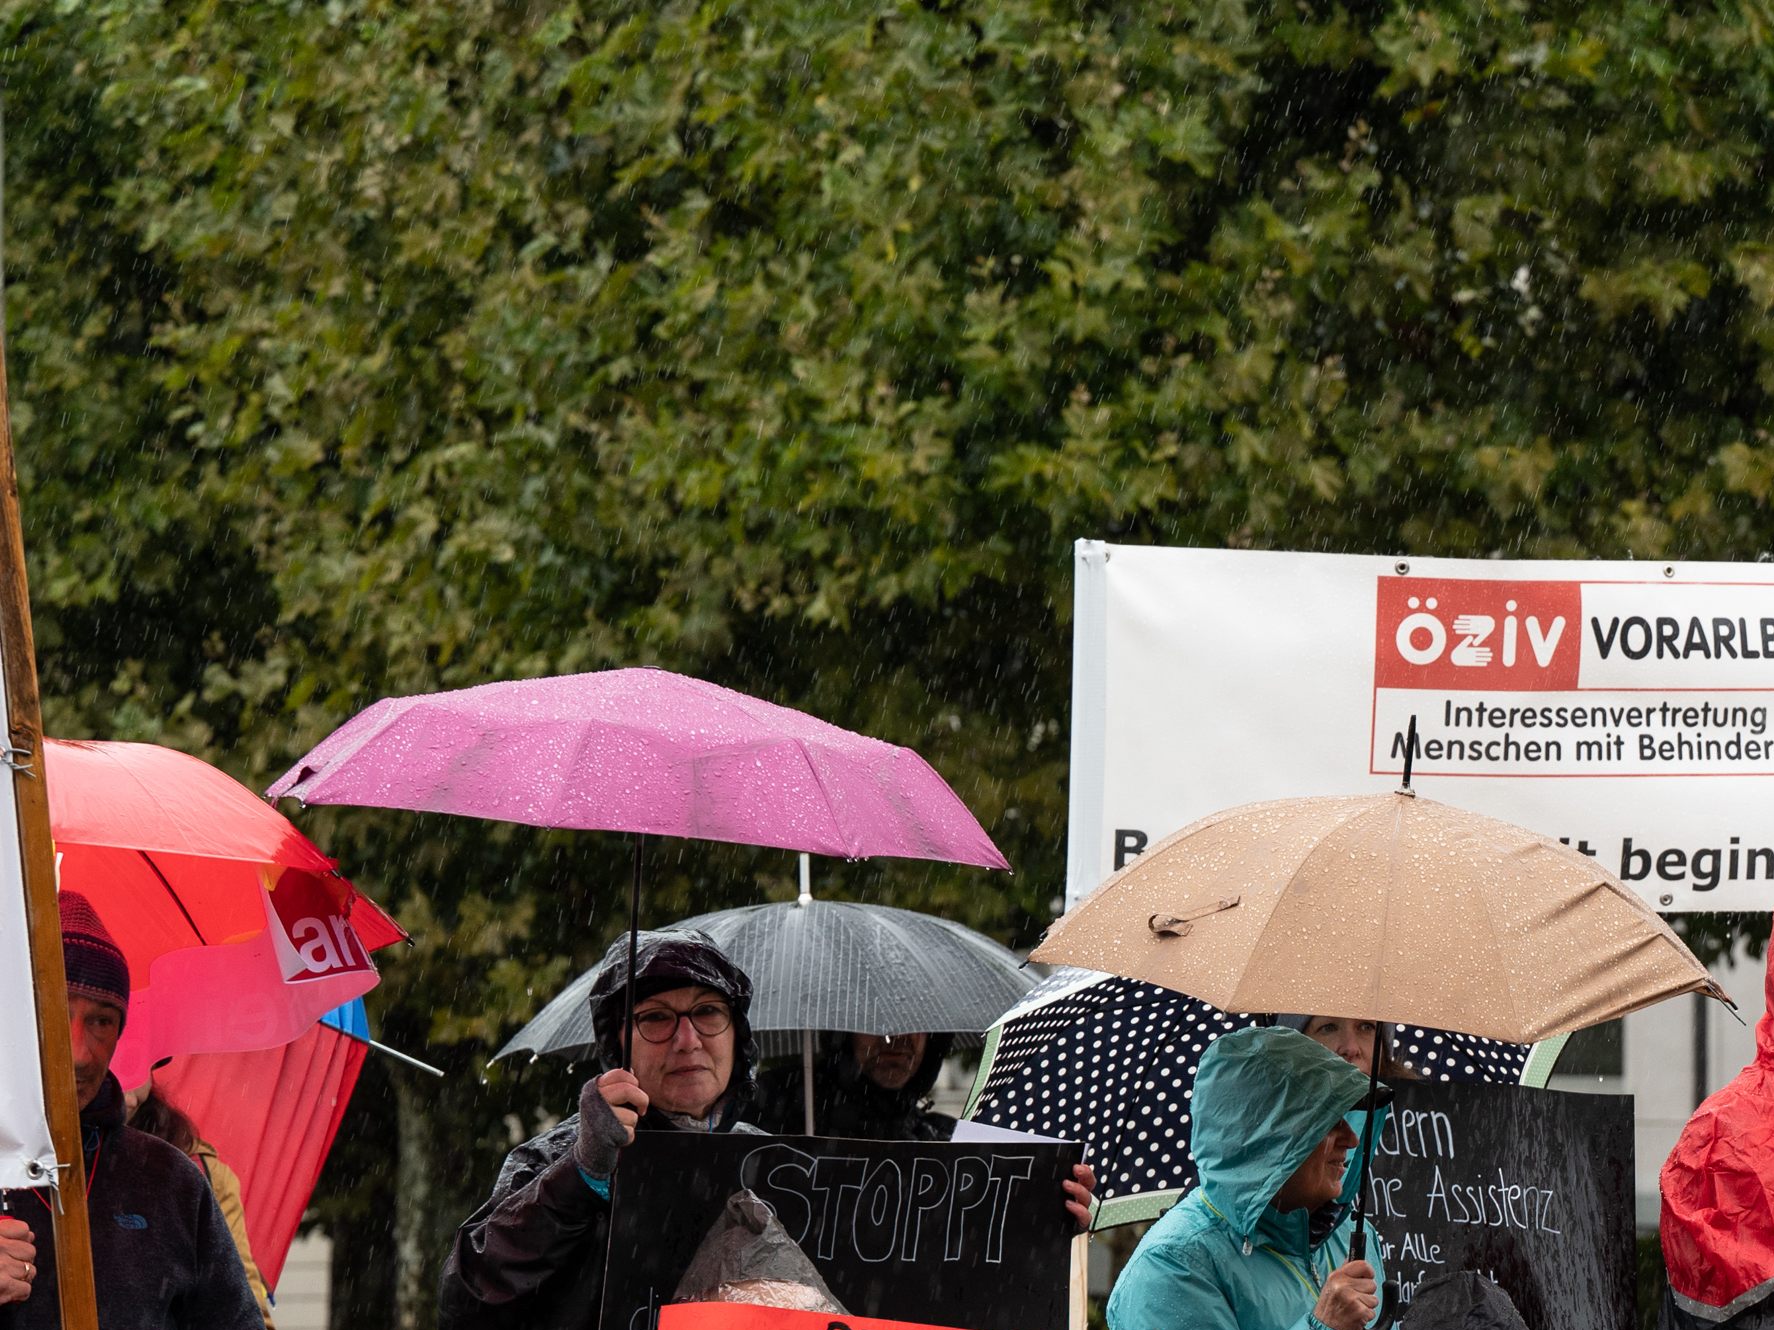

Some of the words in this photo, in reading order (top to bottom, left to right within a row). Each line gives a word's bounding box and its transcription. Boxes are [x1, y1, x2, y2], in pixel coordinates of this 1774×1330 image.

[1444, 700, 1768, 735] Interessenvertretung
[1391, 731, 1561, 762] Menschen
[1575, 734, 1625, 761] mit
[740, 1143, 1035, 1264] STOPPT
[1426, 1165, 1561, 1234] Assistenz
[1400, 1232, 1445, 1264] Alle
